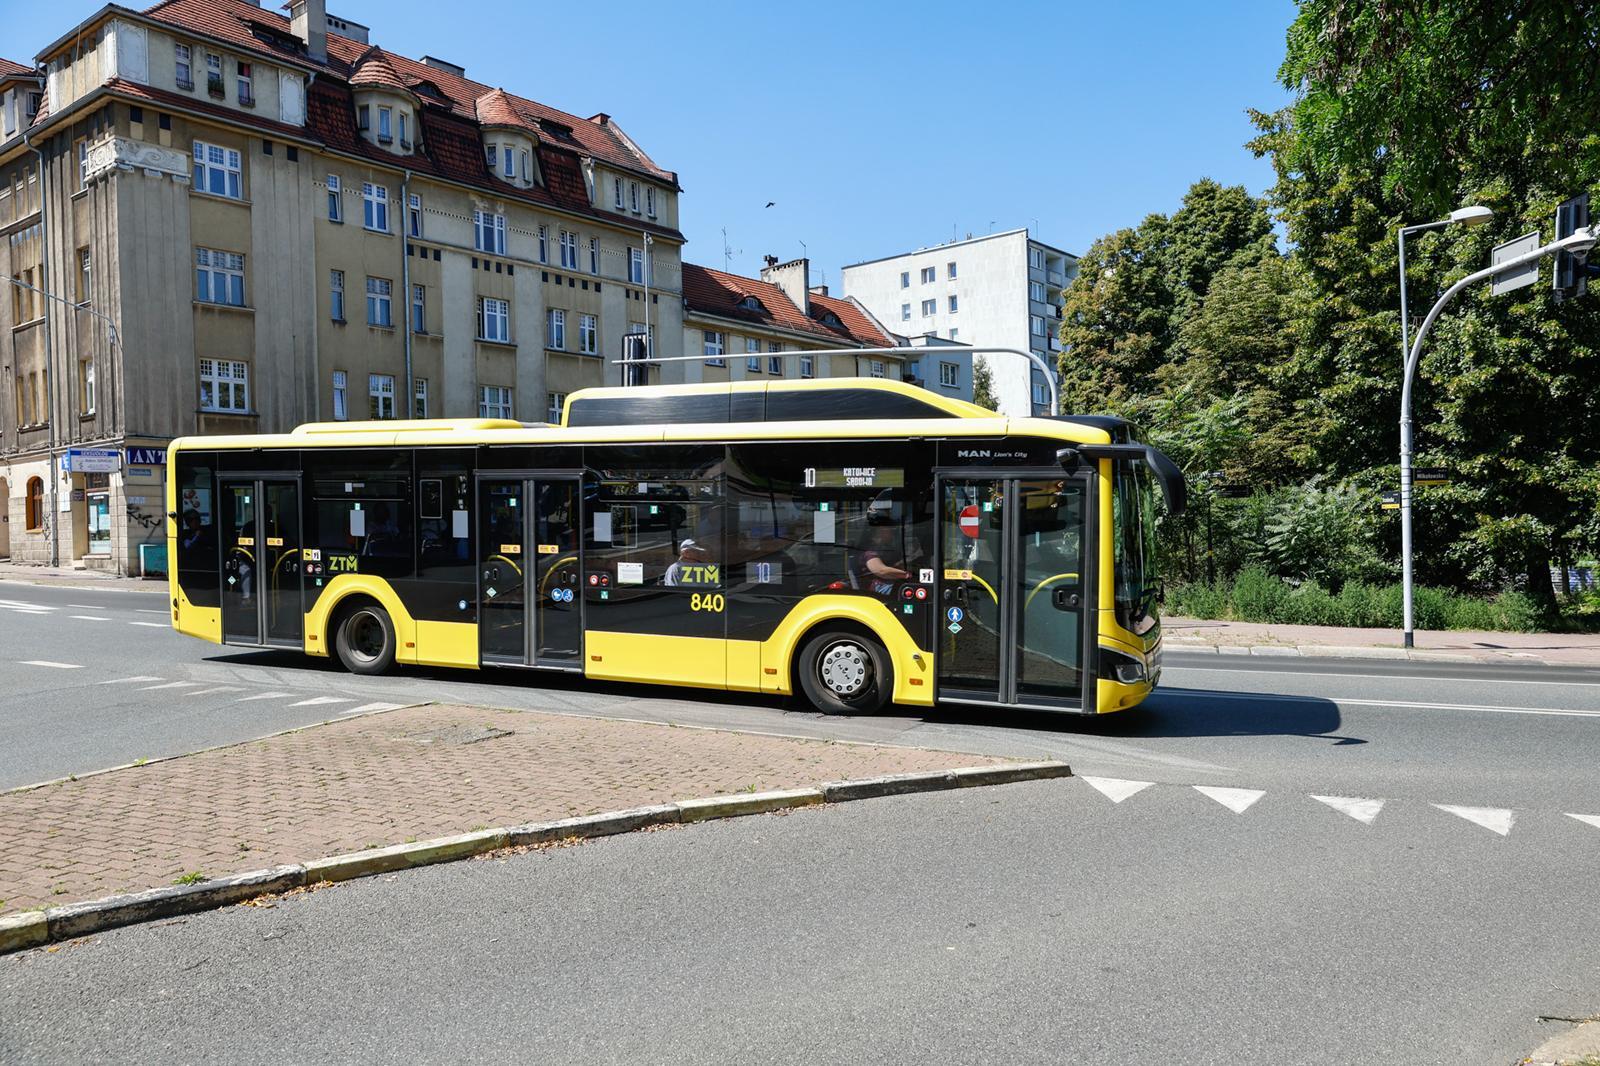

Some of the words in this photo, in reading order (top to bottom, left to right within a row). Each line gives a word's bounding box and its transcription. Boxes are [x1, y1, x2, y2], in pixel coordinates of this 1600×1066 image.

[803, 467, 816, 488] 10
[843, 467, 876, 477] KATOWICE
[329, 555, 358, 571] ZTM
[681, 565, 719, 584] ZTM
[756, 562, 770, 584] 10
[690, 593, 725, 612] 840
